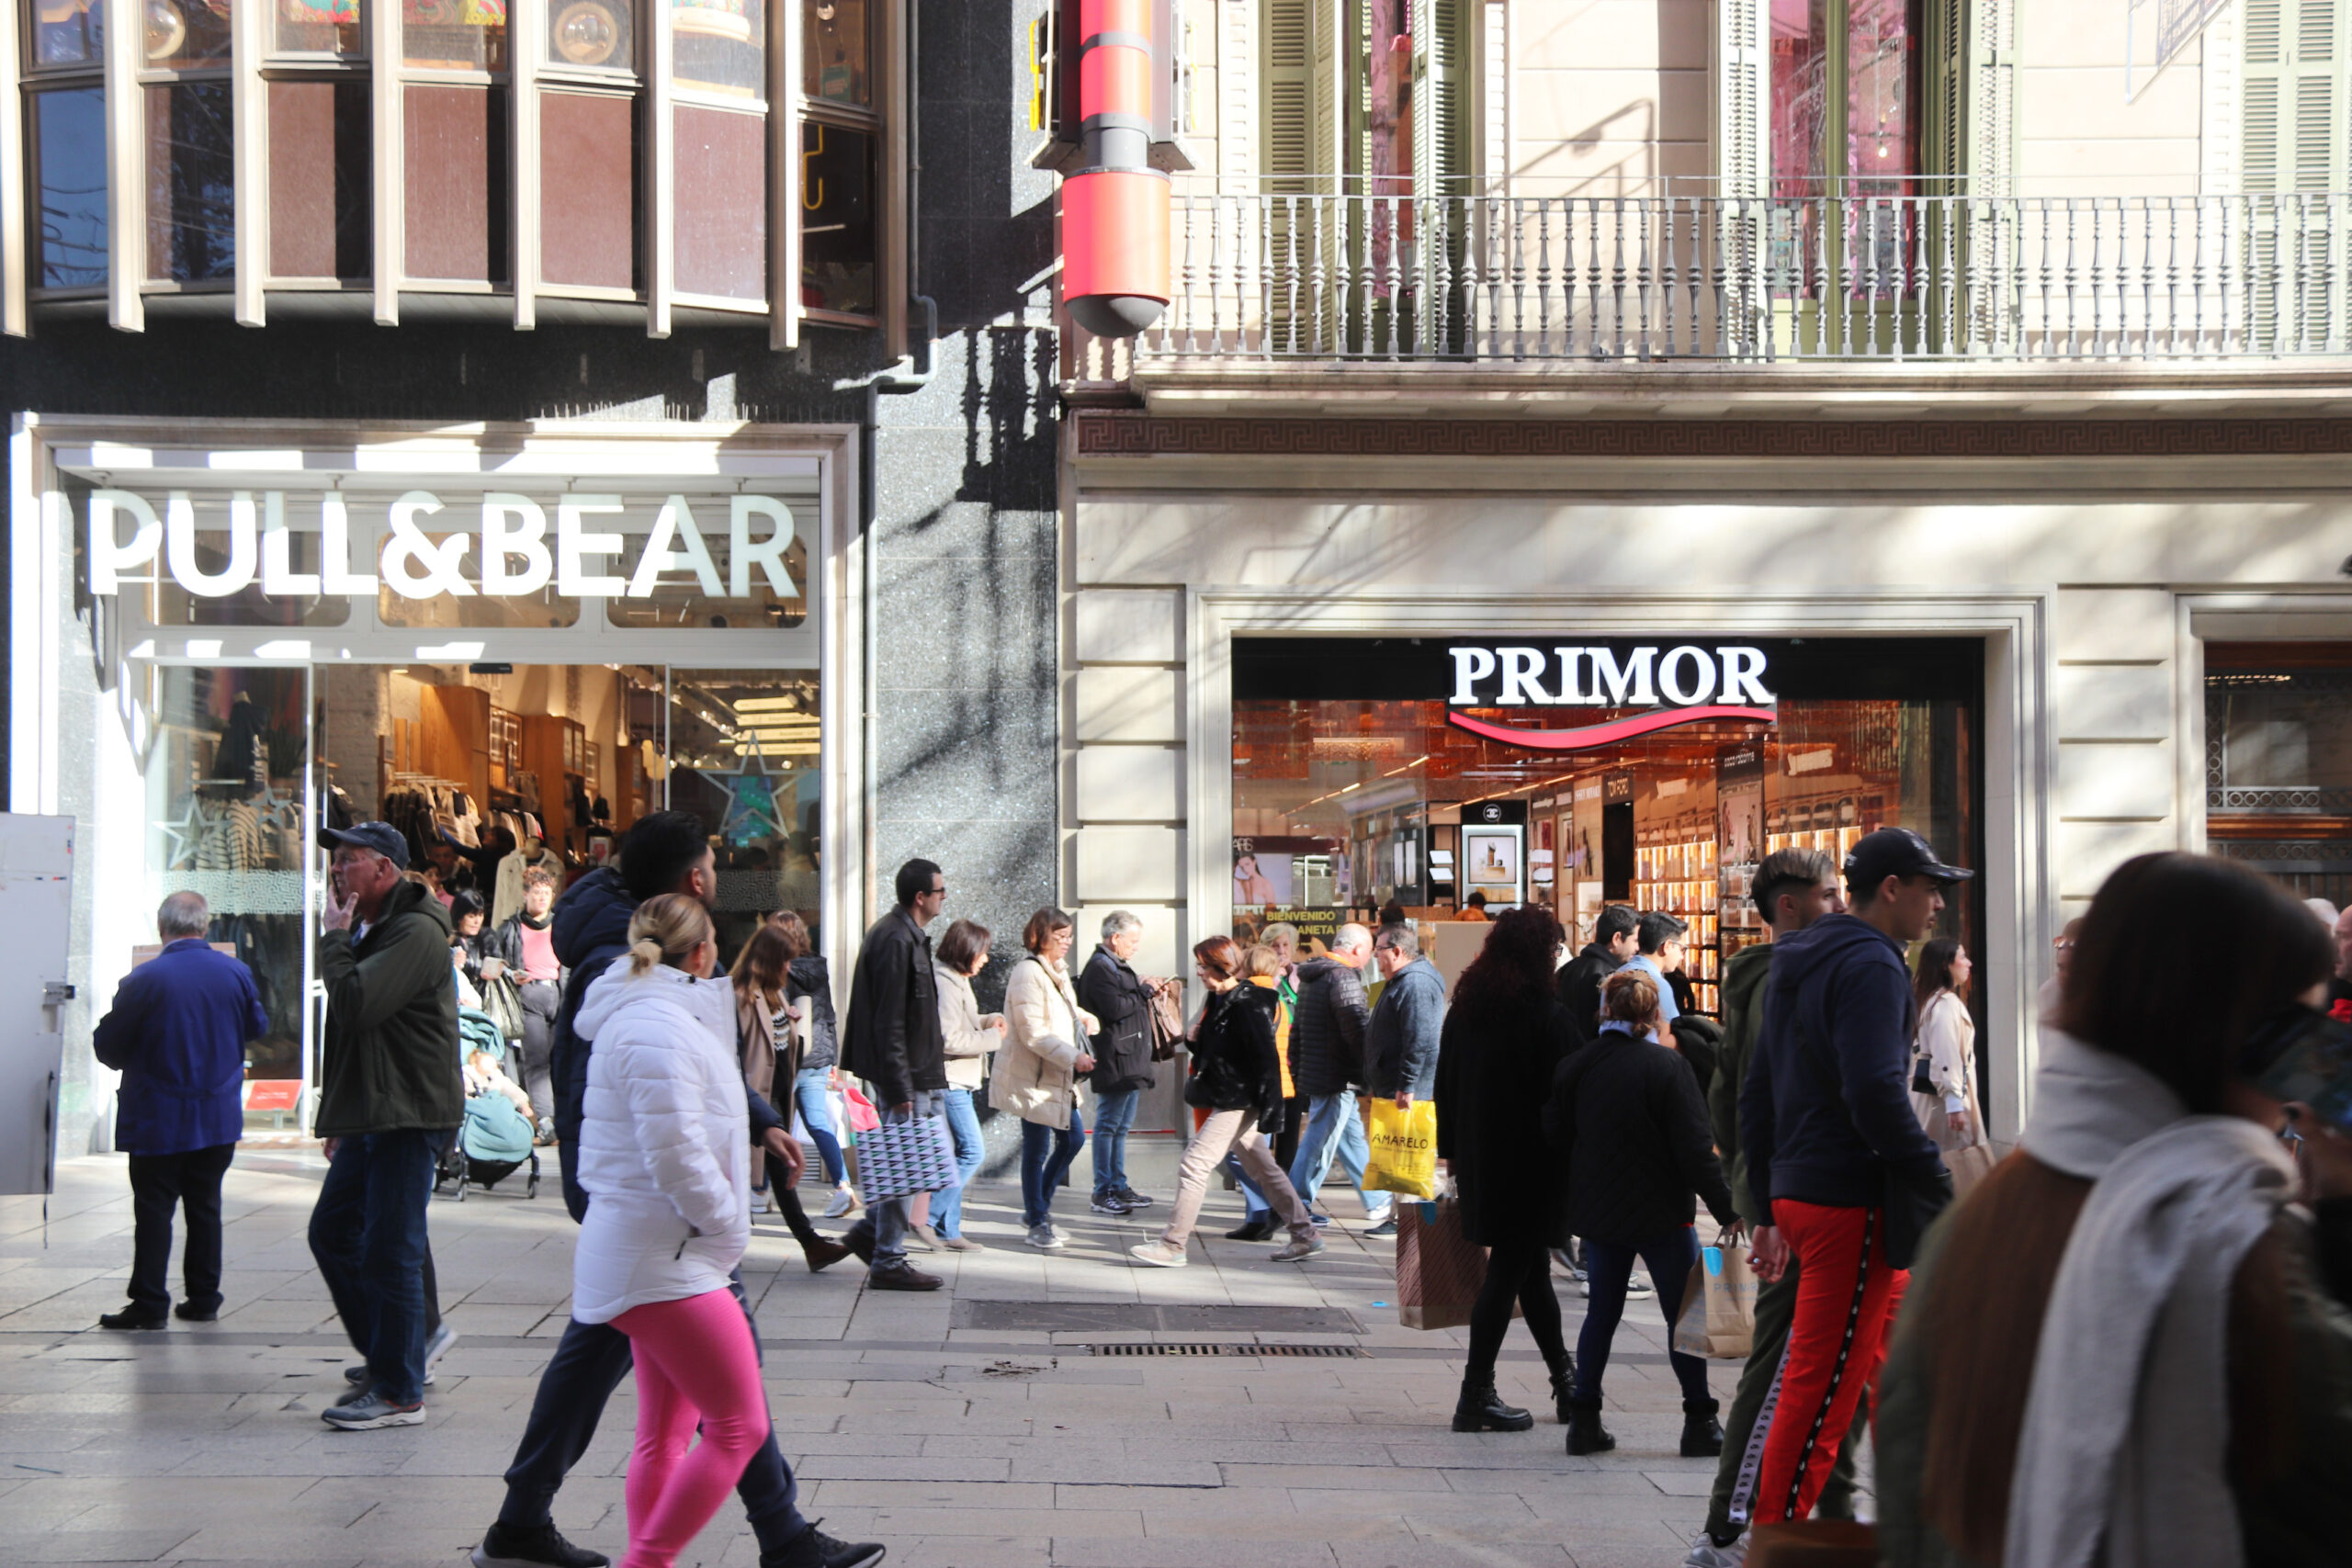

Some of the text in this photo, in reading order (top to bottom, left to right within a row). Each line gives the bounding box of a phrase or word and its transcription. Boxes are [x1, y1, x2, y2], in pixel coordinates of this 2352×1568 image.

[90, 489, 799, 600] PULL&BEAR
[1449, 646, 1775, 705] PRIMOR
[1266, 910, 1336, 921] BIENVENIDO
[1297, 924, 1335, 935] ANETA
[1372, 1134, 1429, 1149] AMARELO
